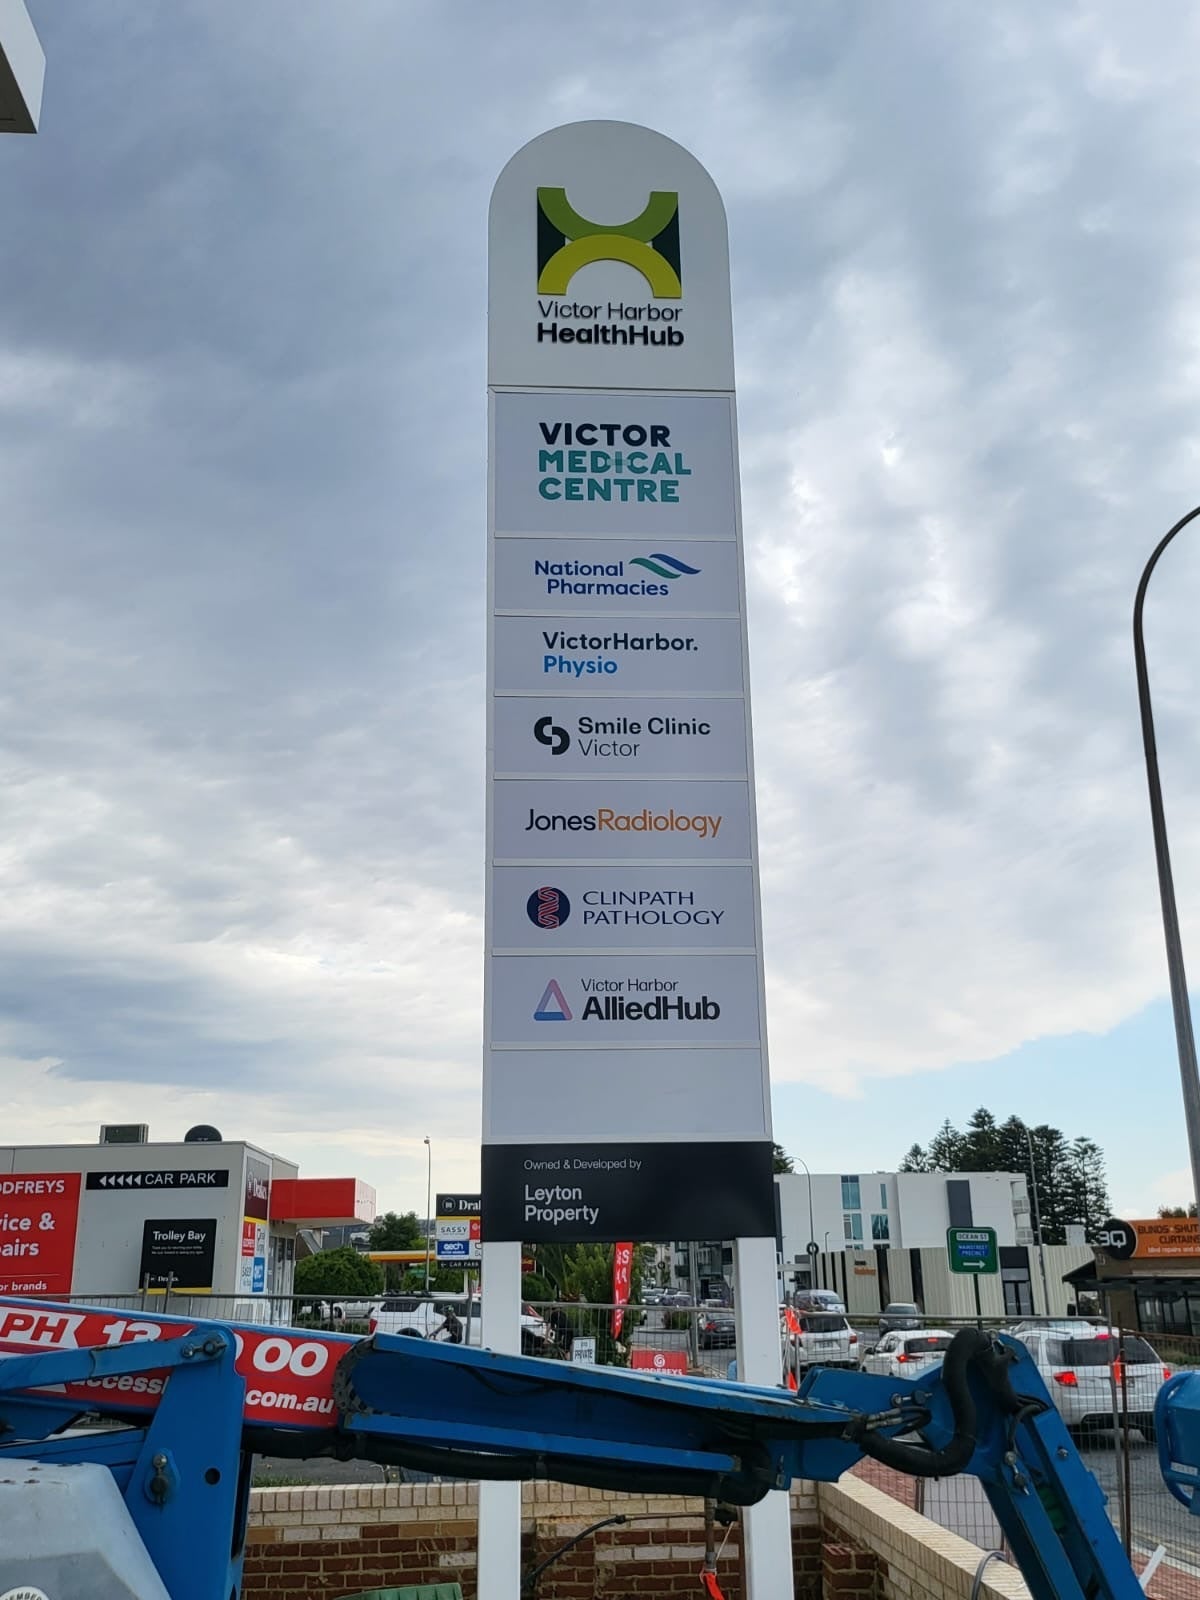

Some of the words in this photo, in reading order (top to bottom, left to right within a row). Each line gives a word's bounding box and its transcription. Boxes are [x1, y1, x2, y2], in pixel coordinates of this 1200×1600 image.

[537, 300, 603, 320] Victor
[608, 302, 684, 322] Harbor
[537, 322, 685, 347] HealthHub
[538, 421, 671, 447] VICTOR
[538, 449, 692, 475] MEDICAL
[537, 477, 680, 503] CENTRE
[534, 560, 624, 577] National
[547, 578, 670, 596] Pharmacies
[542, 631, 699, 652] VictorHarbor.
[543, 655, 618, 678] Physio
[578, 716, 642, 735] Smile
[647, 717, 711, 736] Clinic
[578, 739, 640, 757] Victor
[582, 890, 695, 906] CLINPATH
[583, 910, 725, 926] PATHOLOGY
[581, 978, 624, 992] Victor
[627, 978, 680, 992] Harbor
[581, 995, 721, 1021] AlliedHub
[523, 1159, 560, 1170] Owned
[563, 1159, 571, 1169] &
[573, 1159, 627, 1171] Developed
[629, 1158, 642, 1171] by
[0, 1180, 65, 1195] DFREYS
[144, 1173, 174, 1185] CAR
[179, 1172, 217, 1184] PARK
[524, 1184, 583, 1206] Leyton
[0, 1213, 32, 1232] ice
[38, 1212, 56, 1231] &
[524, 1205, 600, 1226] Property
[152, 1229, 186, 1244] Trolley
[187, 1230, 207, 1244] Bay
[0, 1238, 40, 1257] airs
[11, 1281, 47, 1292] brands
[1, 1312, 69, 1344] PH
[252, 1337, 329, 1377] 00
